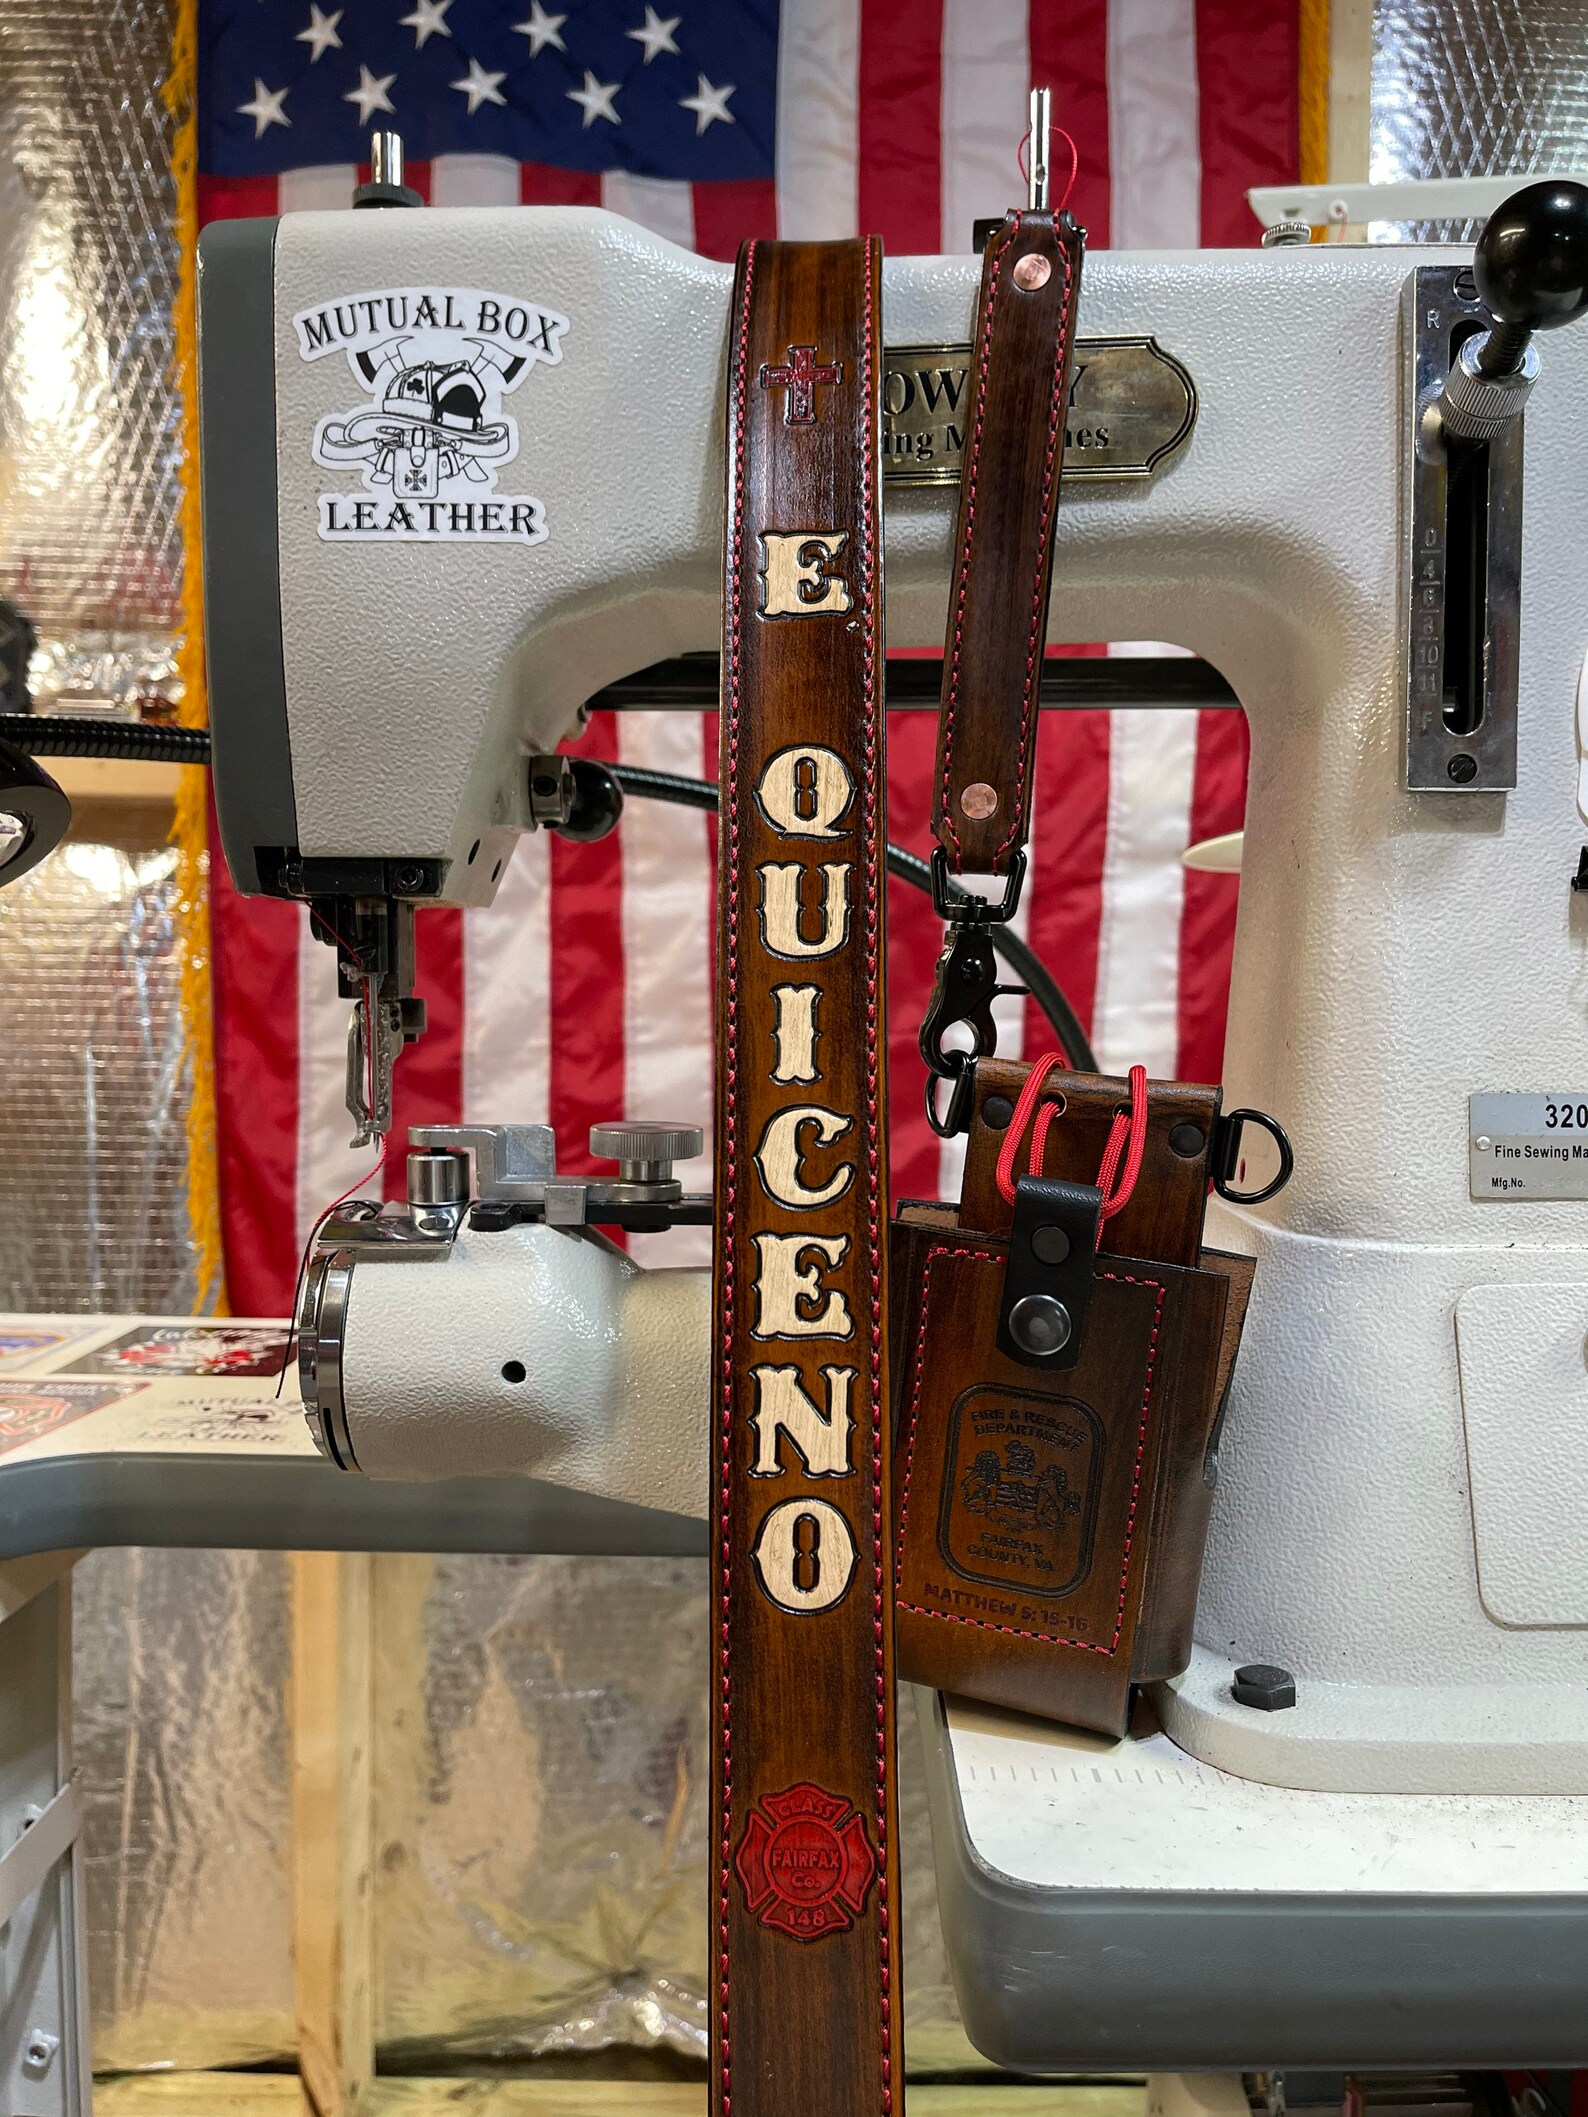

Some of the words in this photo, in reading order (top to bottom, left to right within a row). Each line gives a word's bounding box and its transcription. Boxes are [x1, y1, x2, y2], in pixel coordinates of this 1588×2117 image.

[301, 295, 465, 353] MUTUAL
[478, 300, 562, 355] BOX
[1427, 309, 1440, 328] R
[326, 501, 538, 536] LEATHER
[1425, 527, 1436, 547] 0
[1423, 559, 1435, 579] 4
[1495, 1145, 1521, 1158] Fine
[1524, 1145, 1569, 1161] Sewing
[749, 745, 860, 1614] QUICENO
[1491, 1177, 1526, 1190] Mfg.No.
[970, 1408, 1005, 1422] FIRE
[1024, 1411, 1088, 1442] RESCUE
[981, 1532, 1044, 1556] FAIRFAX
[923, 1583, 1018, 1616] MATTHEW
[778, 1797, 834, 1818] CLASS
[772, 1850, 840, 1868] FAIRFAX
[787, 1909, 826, 1926] 148
